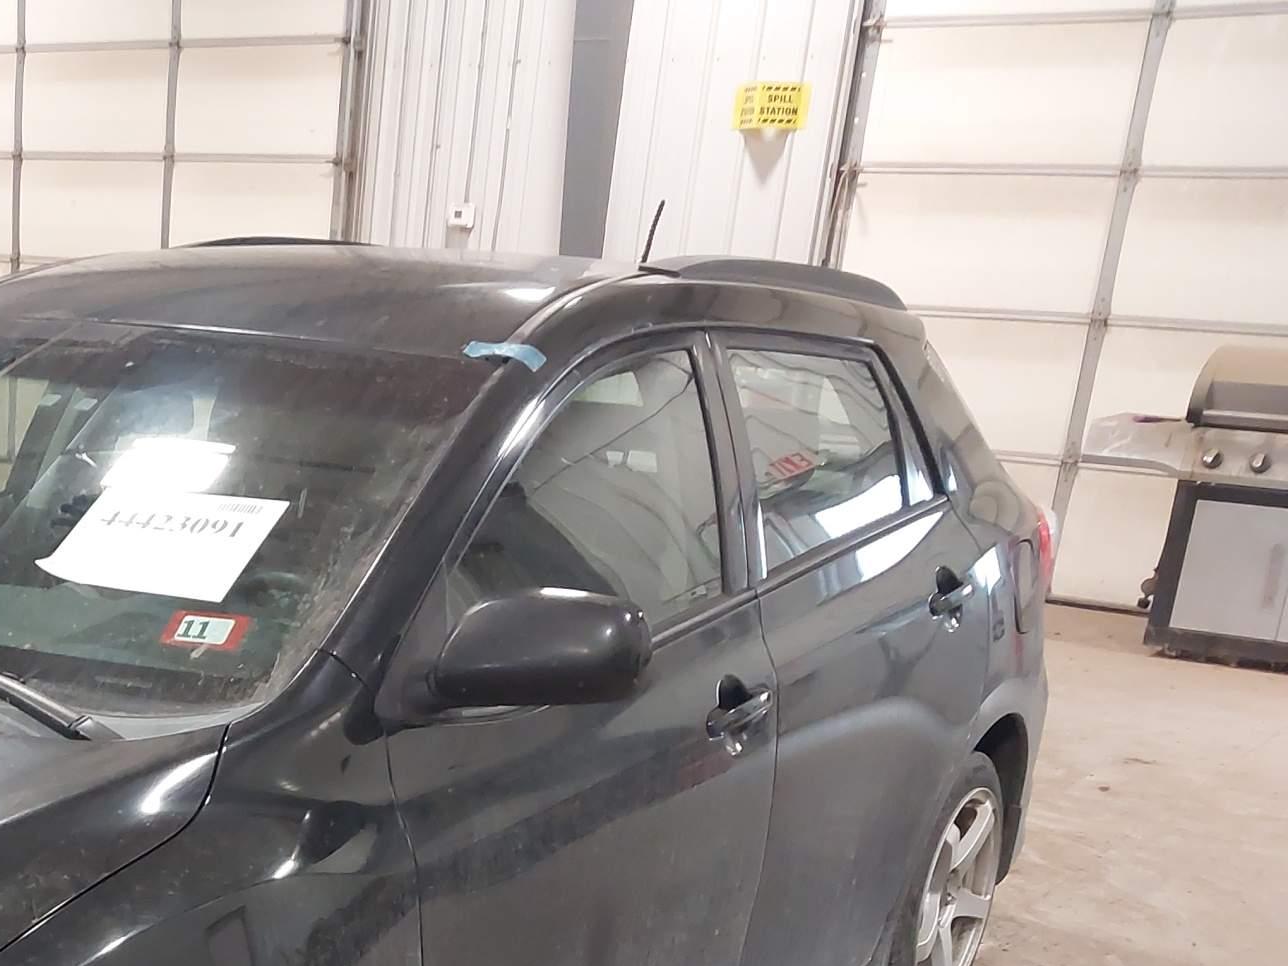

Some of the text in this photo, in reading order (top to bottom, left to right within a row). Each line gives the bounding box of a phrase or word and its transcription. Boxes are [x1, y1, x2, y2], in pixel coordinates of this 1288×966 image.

[768, 94, 793, 103] SPILL
[759, 106, 799, 116] STATION
[99, 511, 244, 538] 44423091
[176, 619, 210, 640] 11
